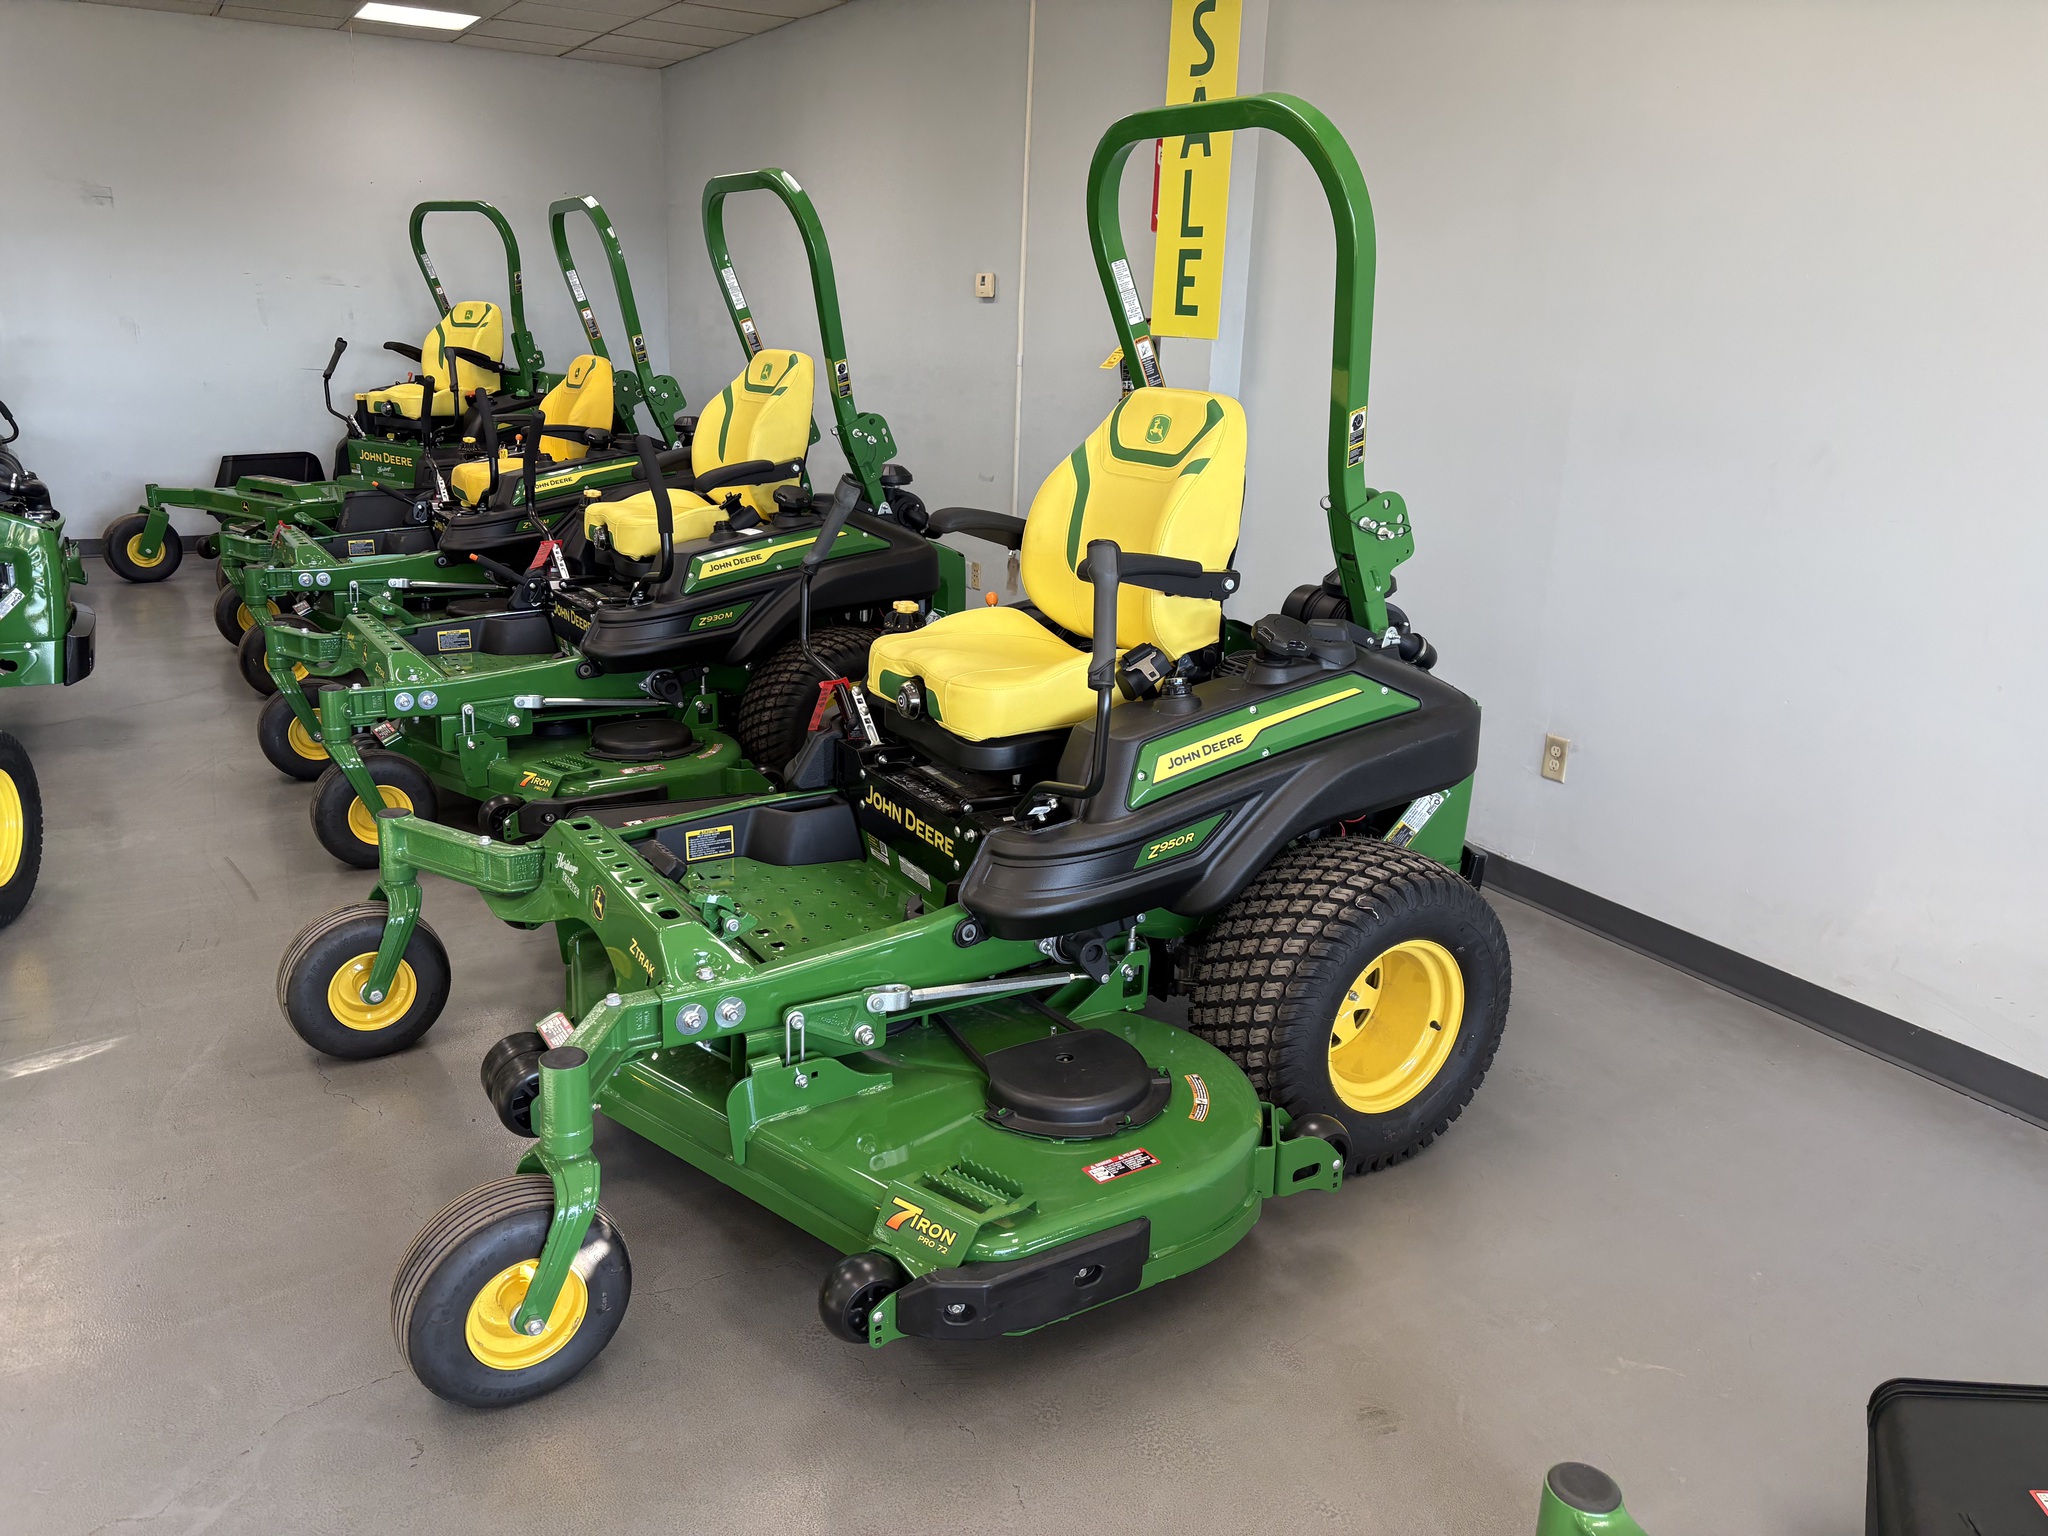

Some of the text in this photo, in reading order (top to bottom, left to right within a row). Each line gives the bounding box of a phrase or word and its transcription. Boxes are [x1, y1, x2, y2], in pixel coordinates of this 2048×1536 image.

[360, 449, 413, 467] JOHN DEERE
[550, 477, 573, 486] DEERE
[709, 554, 762, 572] JOHN DEERE
[553, 600, 570, 621] JOHN
[699, 611, 733, 626] Z930M
[1168, 734, 1244, 769] JOHN DEERE
[865, 785, 902, 824] JOHN
[905, 807, 954, 858] DEERE
[1147, 832, 1195, 860] Z950R
[555, 851, 579, 877] Heritage
[629, 937, 655, 978] ZTRAK
[917, 1235, 948, 1255] PRO 72
